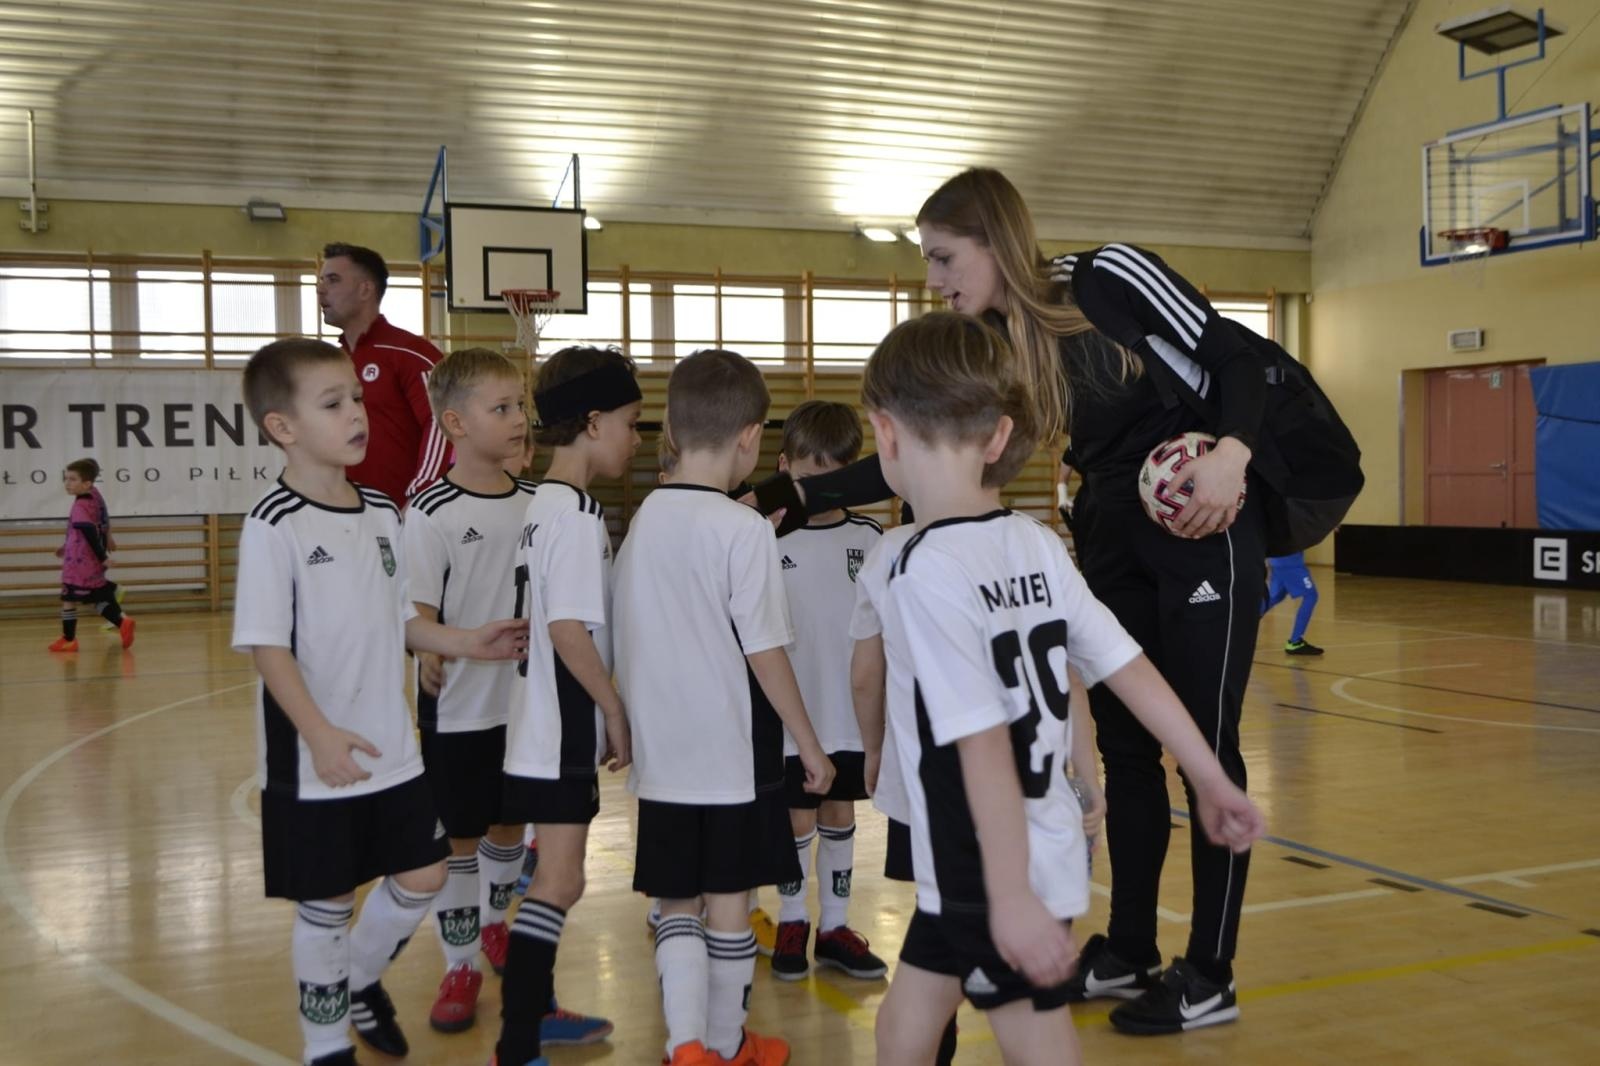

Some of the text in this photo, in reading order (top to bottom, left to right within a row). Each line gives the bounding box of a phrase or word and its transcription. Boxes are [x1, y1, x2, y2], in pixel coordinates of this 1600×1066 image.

[2, 403, 269, 449] R TREN
[2, 466, 286, 485] ŁOGO PIŁK
[978, 571, 1052, 613] MCIEJ
[1188, 593, 1221, 604] adidas
